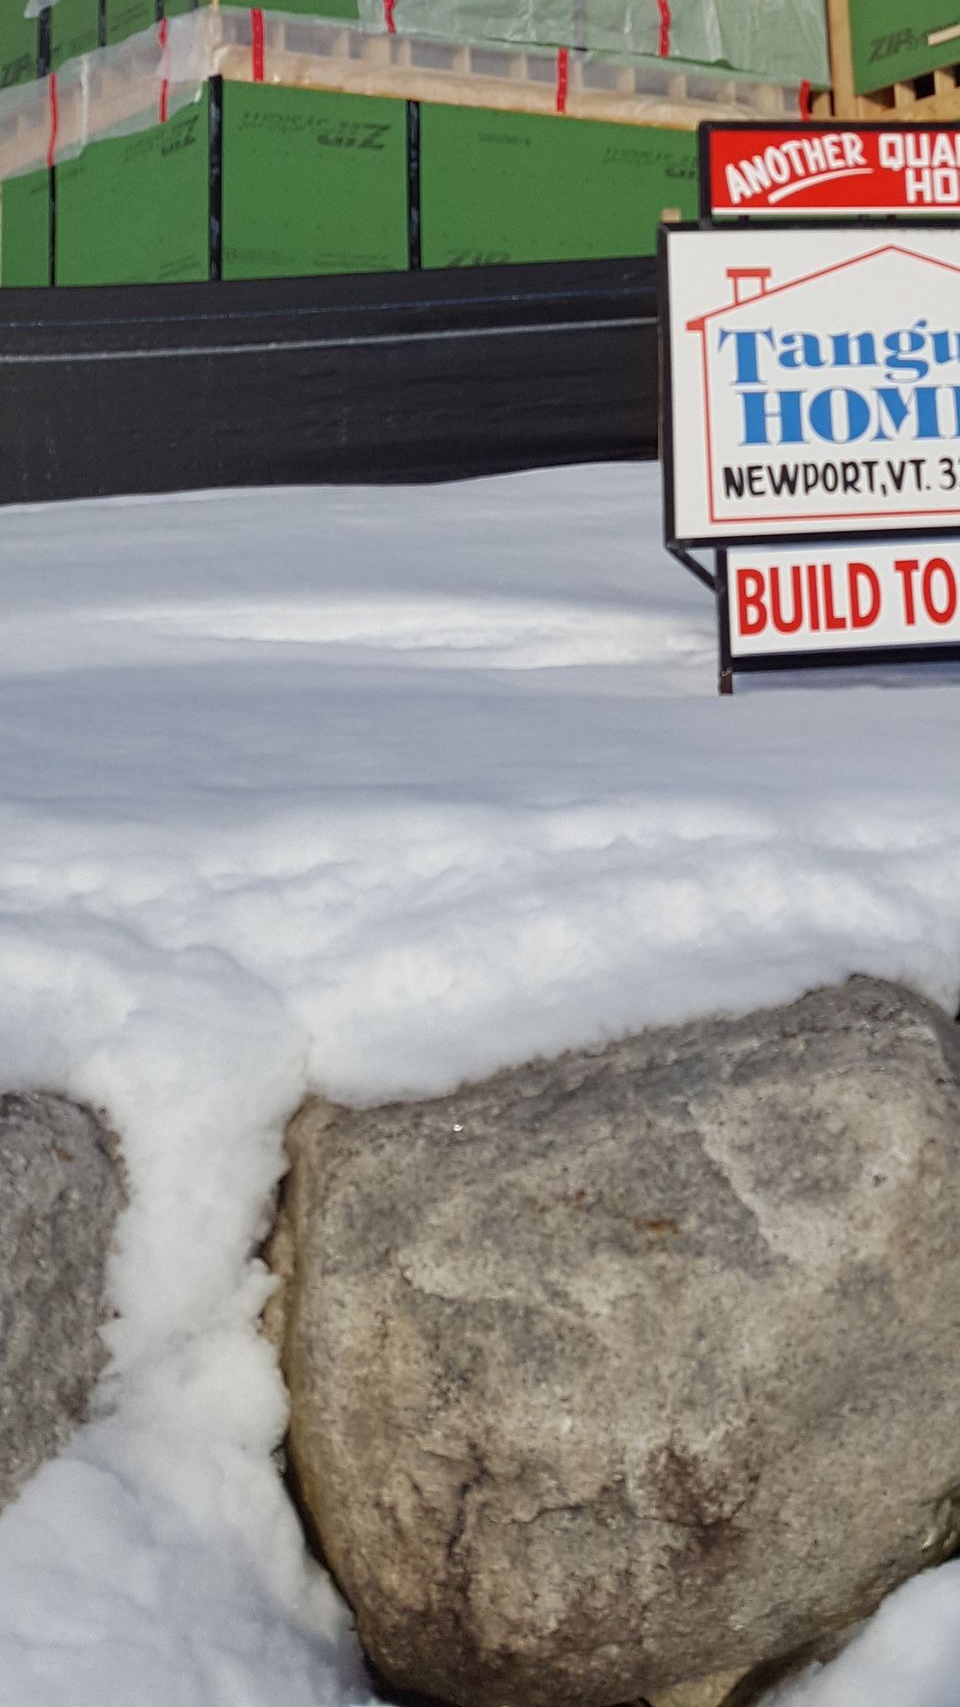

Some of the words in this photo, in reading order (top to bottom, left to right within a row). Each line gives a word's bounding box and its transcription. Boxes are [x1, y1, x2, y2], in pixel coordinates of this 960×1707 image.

[726, 133, 866, 202] ANOTHER
[735, 563, 881, 638] BUILD
[895, 557, 959, 627] TO
